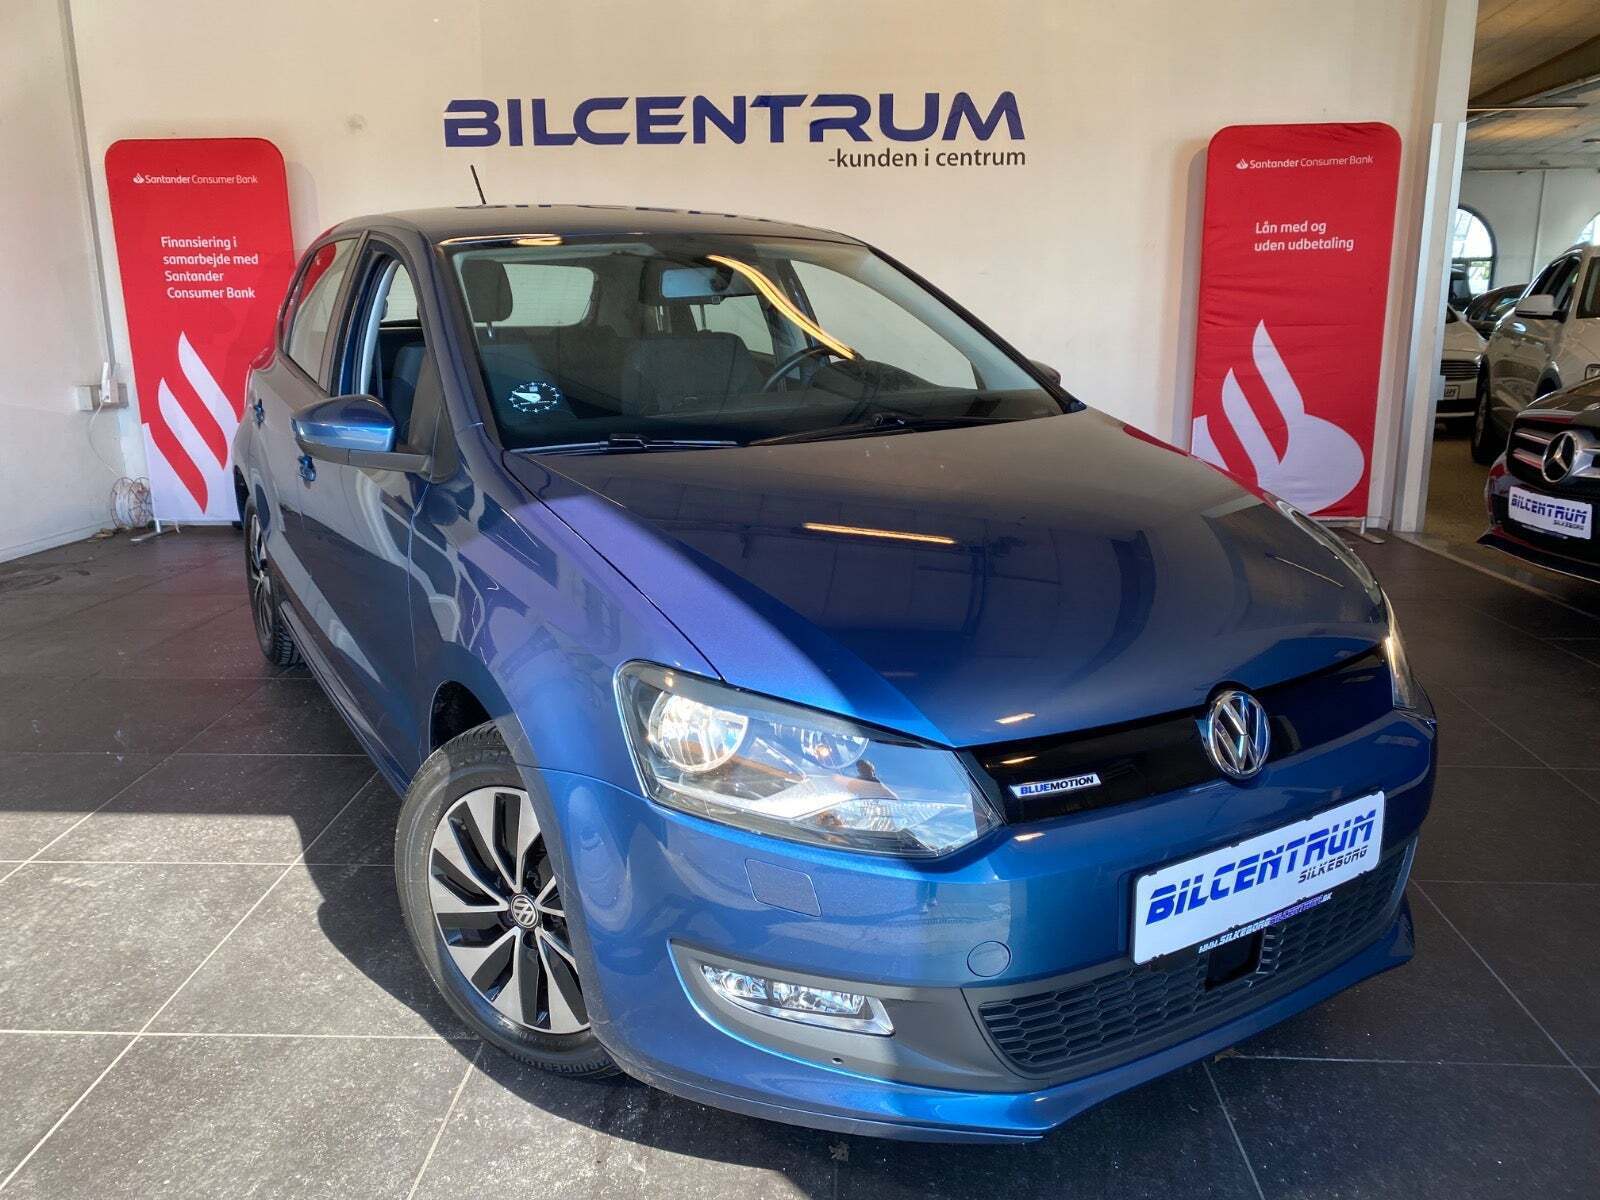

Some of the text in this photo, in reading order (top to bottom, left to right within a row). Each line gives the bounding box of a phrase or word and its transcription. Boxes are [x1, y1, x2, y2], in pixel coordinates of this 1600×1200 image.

[444, 91, 1025, 147] BILCENTRUM
[828, 148, 1026, 168] -kunden i centrum
[1250, 155, 1374, 169] Santander Consumer Bank
[145, 174, 258, 184] Santander Consumer Bank
[1255, 220, 1327, 235] Lån med og
[161, 236, 238, 250] Finansiering i
[1254, 237, 1354, 251] uden udbetaling
[163, 253, 259, 268] samarbejde med
[164, 270, 224, 282] Santander
[167, 287, 256, 299] Consumer Bank
[1511, 494, 1588, 525] BILCENTRUM
[1019, 775, 1094, 795] BLUEMOTION
[1145, 809, 1376, 925] BILCENTRUM
[1298, 845, 1368, 884] SILKEBORG
